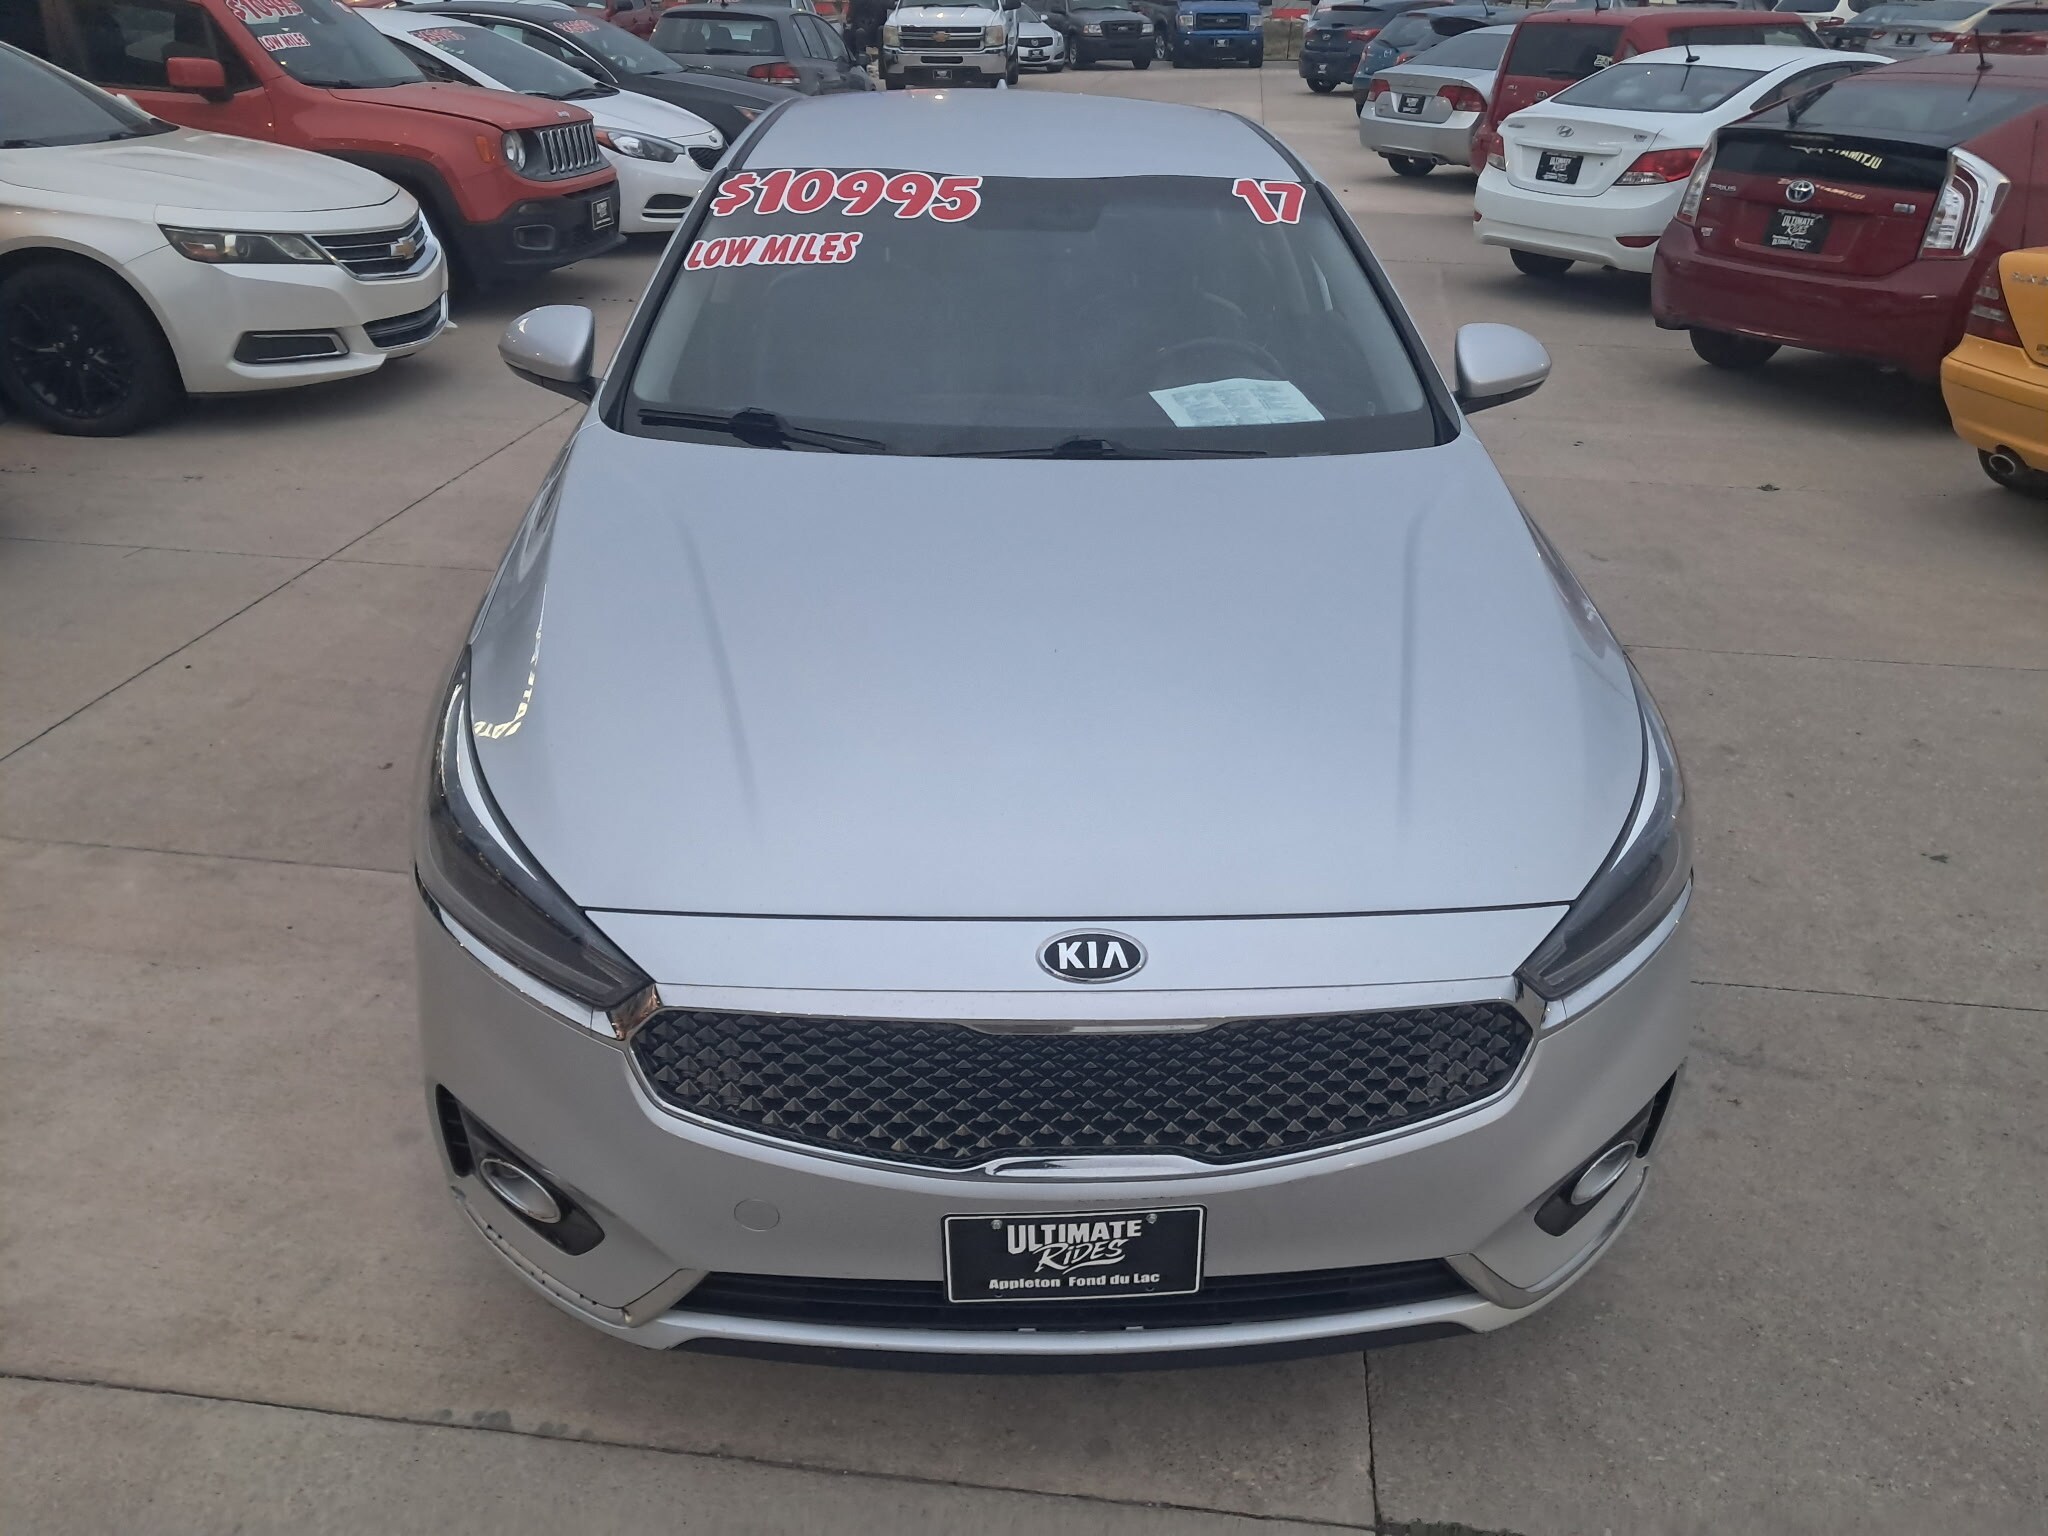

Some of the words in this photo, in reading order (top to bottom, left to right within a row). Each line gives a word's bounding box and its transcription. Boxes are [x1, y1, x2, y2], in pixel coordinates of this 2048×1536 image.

[257, 35, 284, 51] LOW
[279, 32, 311, 48] MILES
[711, 169, 983, 222] $10995
[1232, 178, 1306, 224] 17
[1781, 215, 1815, 227] ULTIMATE
[684, 237, 759, 270] LOW
[758, 232, 863, 264] MILES
[1057, 941, 1129, 970] KIA
[1007, 1219, 1142, 1254] ULTIMATE
[989, 1278, 1061, 1290] Appleton
[1068, 1275, 1106, 1287] Fond
[1110, 1274, 1130, 1285] du
[1133, 1272, 1160, 1284] Lac
